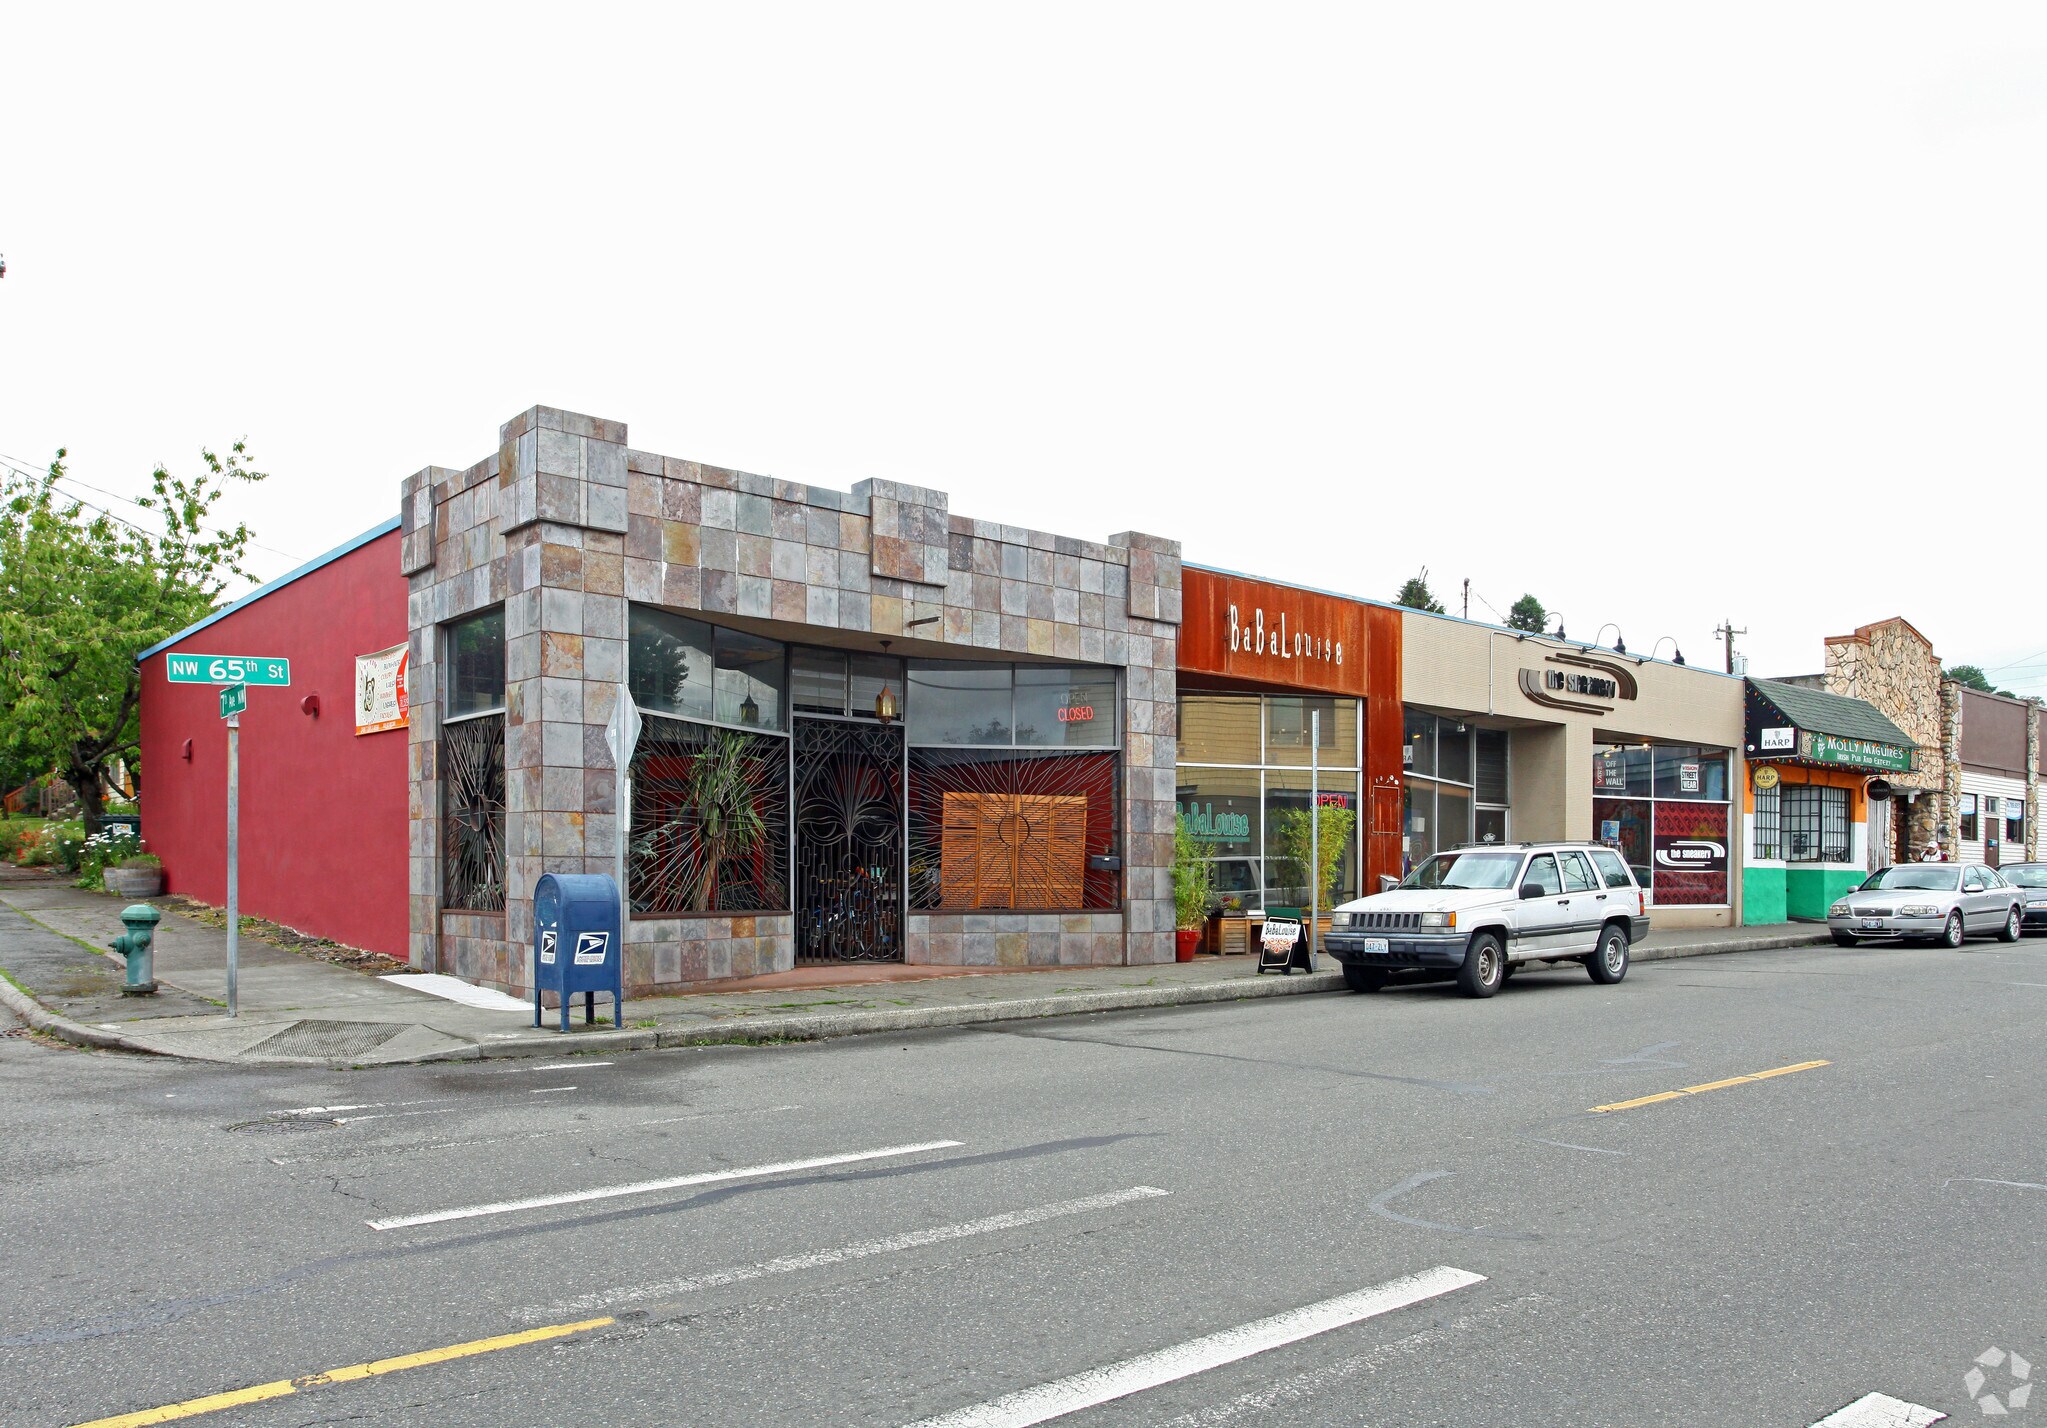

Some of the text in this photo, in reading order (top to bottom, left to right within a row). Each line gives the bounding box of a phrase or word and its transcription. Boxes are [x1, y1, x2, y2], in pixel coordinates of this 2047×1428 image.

[1230, 603, 1342, 665] BaBaLouise
[172, 659, 283, 680] NW 65th St
[1547, 670, 1616, 699] the sneakery
[1060, 692, 1088, 704] OPEN
[1058, 706, 1094, 721] CLOSED
[1764, 738, 1790, 746] HARP
[1828, 737, 1860, 753] MOLLY
[1851, 754, 1862, 762] PUB
[1863, 755, 1873, 763] AND
[1606, 769, 1617, 777] THE
[1682, 771, 1698, 779] STREET
[1682, 780, 1698, 789] WEAR
[1670, 849, 1711, 859] the sneakery
[1265, 923, 1297, 936] BaBaLouise
